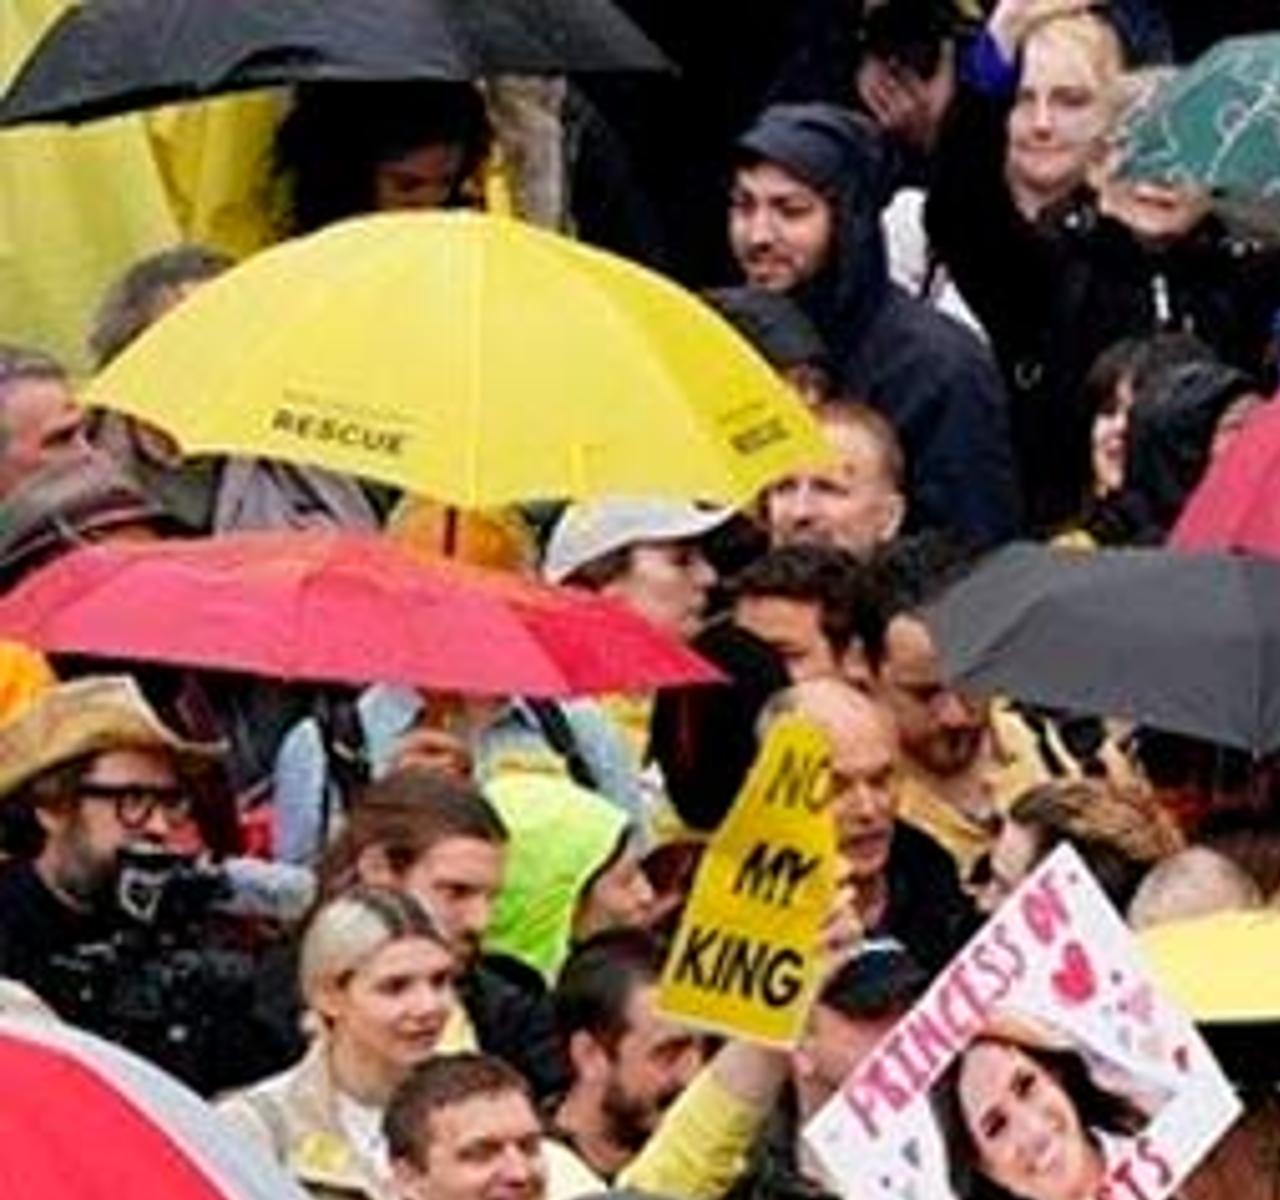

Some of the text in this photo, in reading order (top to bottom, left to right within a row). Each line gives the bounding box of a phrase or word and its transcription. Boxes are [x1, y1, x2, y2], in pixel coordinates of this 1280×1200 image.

[270, 408, 408, 456] RESCUE
[732, 840, 823, 908] MY
[672, 926, 804, 1008] KING
[846, 922, 1027, 1138] PRINCESS
